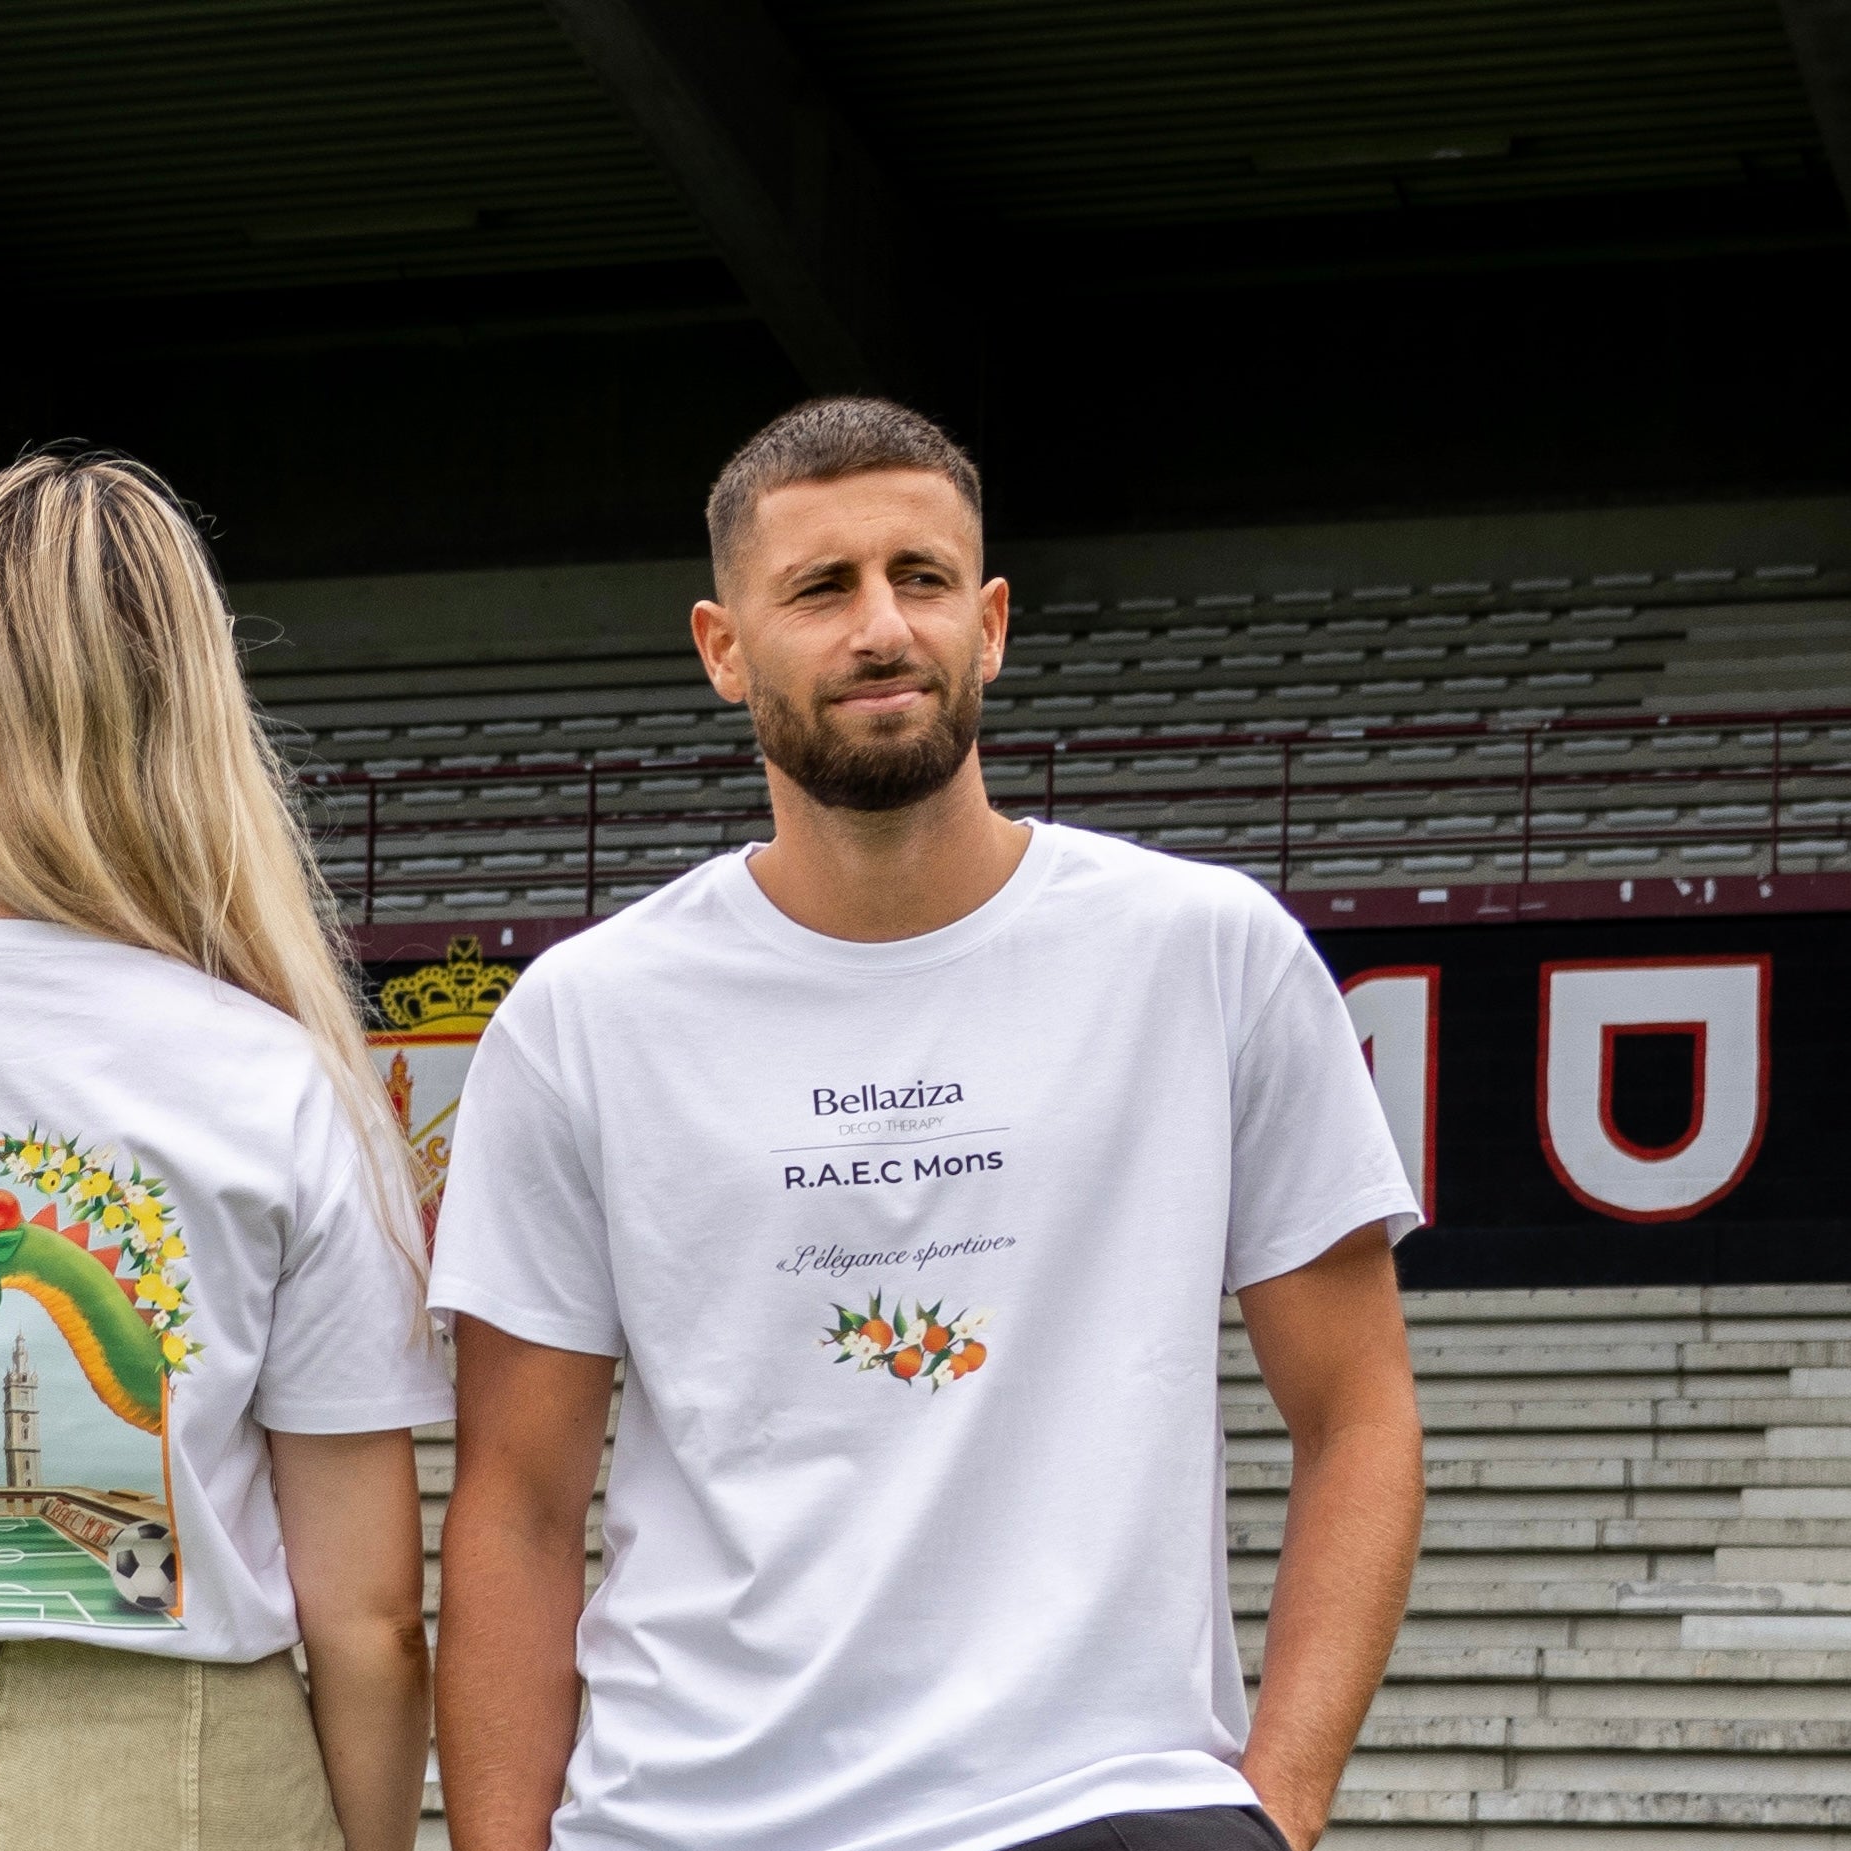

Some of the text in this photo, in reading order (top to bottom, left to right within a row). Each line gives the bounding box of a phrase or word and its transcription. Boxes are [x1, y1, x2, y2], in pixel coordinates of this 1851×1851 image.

[812, 1079, 965, 1116] Bellaziza
[838, 1116, 945, 1136] DECO THERAPY
[784, 1150, 1004, 1190] R.A.E.C Mons
